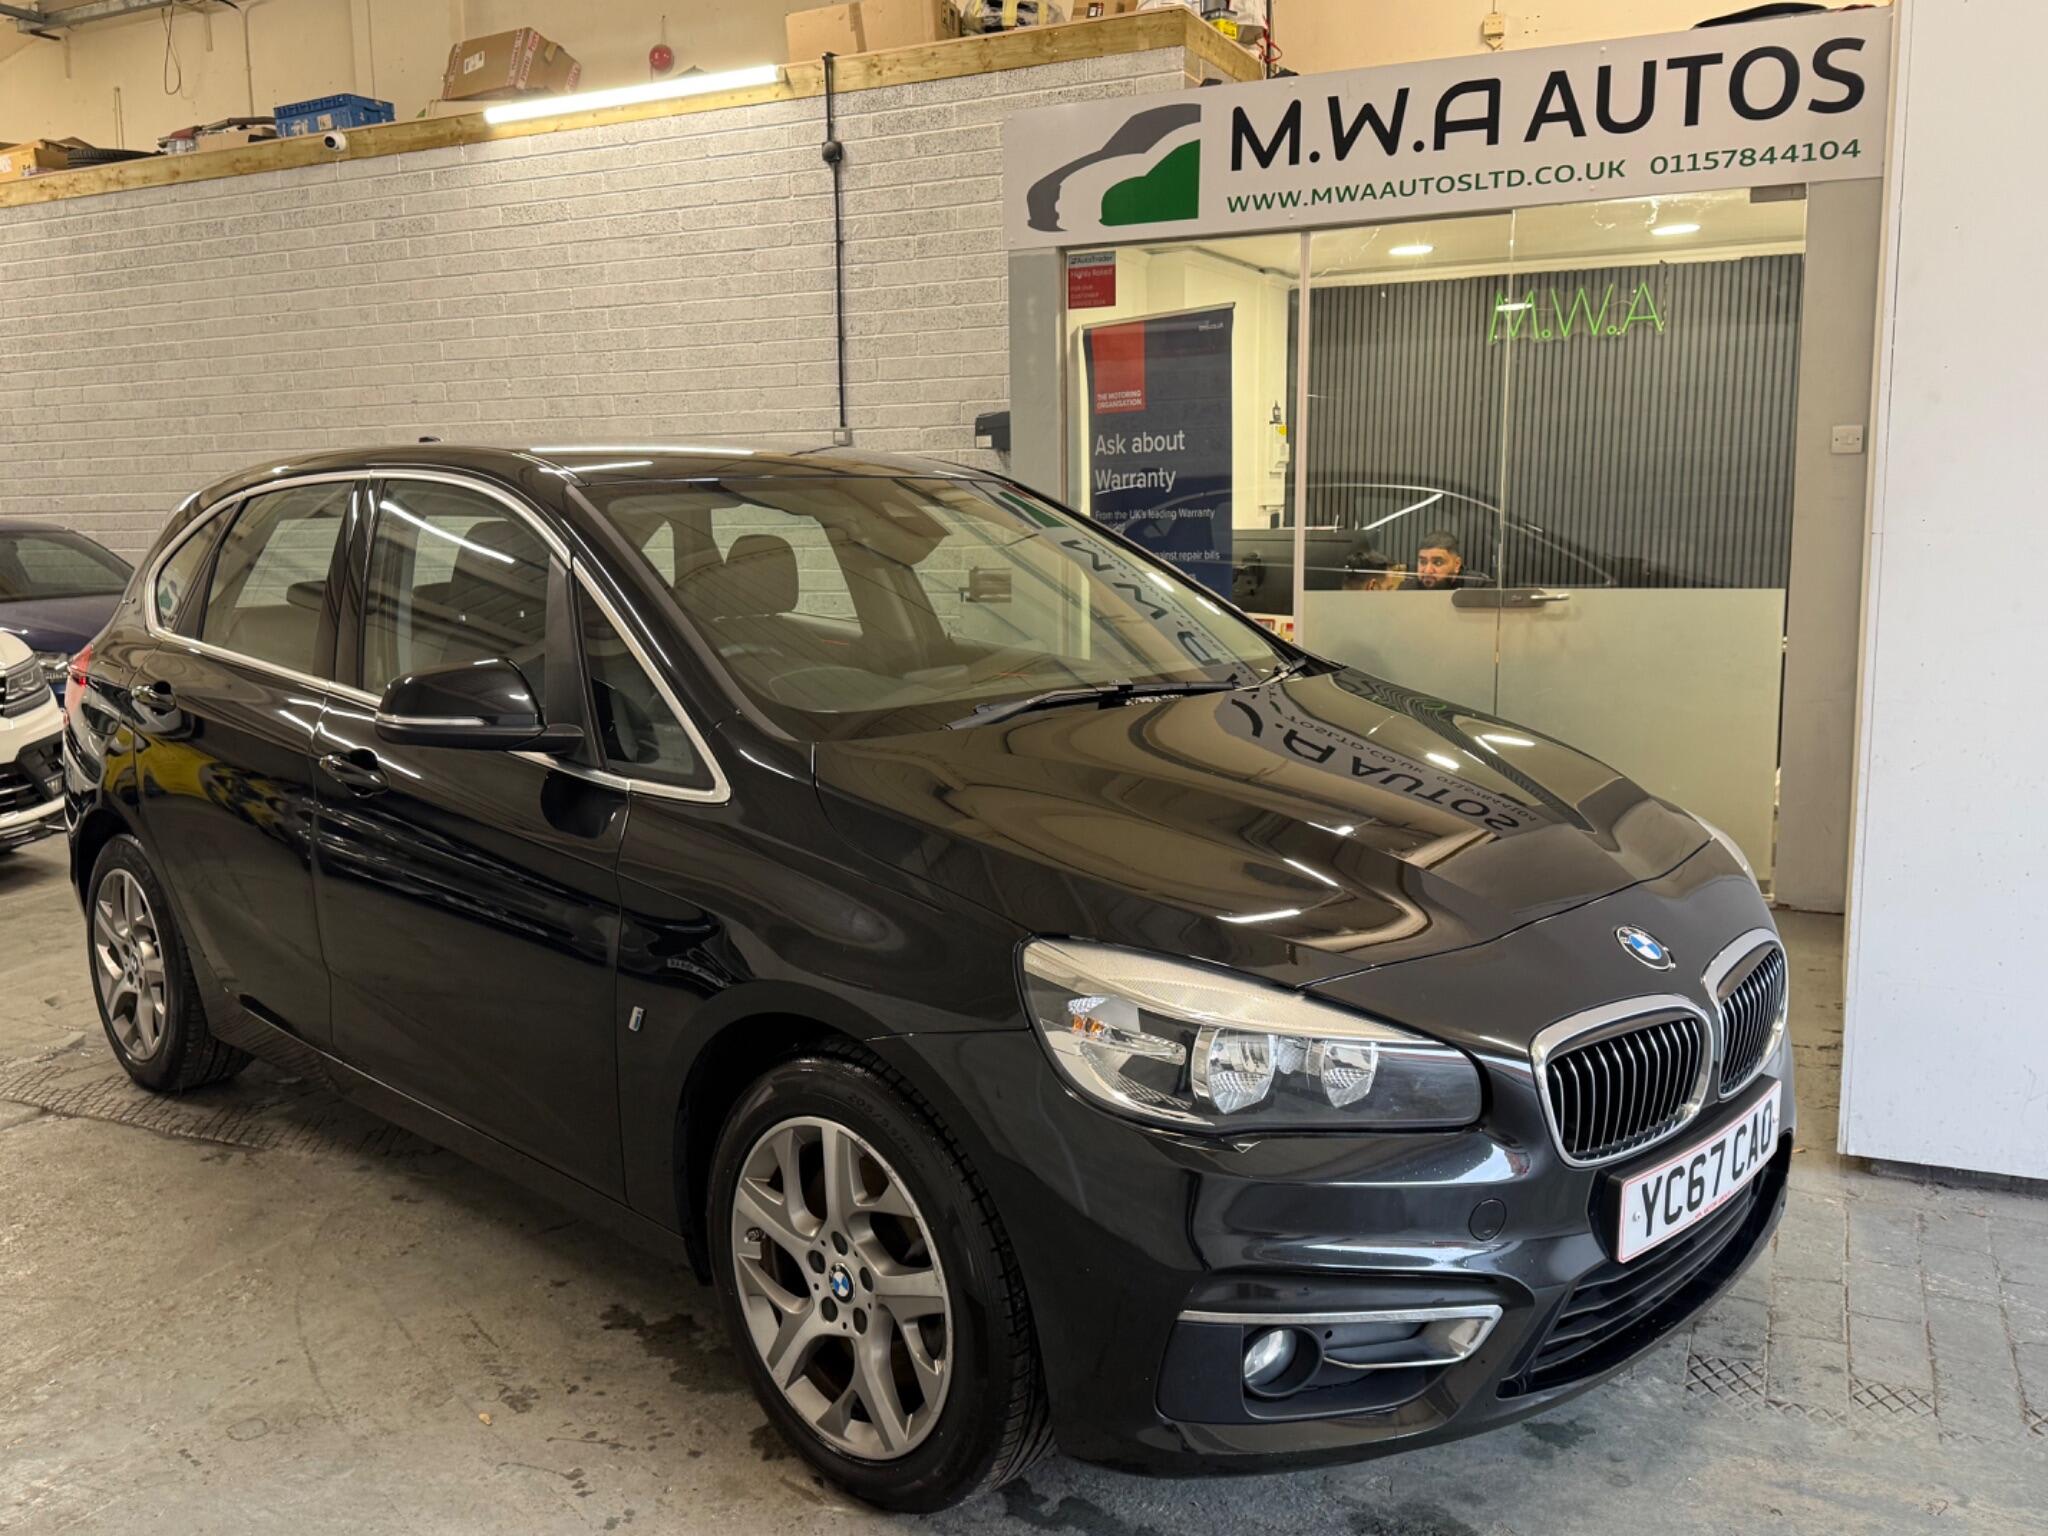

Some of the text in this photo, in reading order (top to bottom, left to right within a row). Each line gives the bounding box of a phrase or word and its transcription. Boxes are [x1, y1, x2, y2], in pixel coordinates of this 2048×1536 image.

[1231, 36, 1866, 171] M.W.A AUTOS
[1226, 138, 1862, 213] WWW.MWAAUTOSLTD.CO.UK 01157844104
[1488, 281, 1664, 343] M.W.A
[1108, 390, 1142, 400] MOTORING
[1095, 429, 1186, 457] Ask about
[1095, 467, 1177, 493] Warranty
[1096, 506, 1216, 520] From the UK's leading Warranty
[1179, 550, 1202, 562] repair
[1204, 549, 1221, 560] bills
[1641, 1098, 1774, 1238] YC67 CAO
